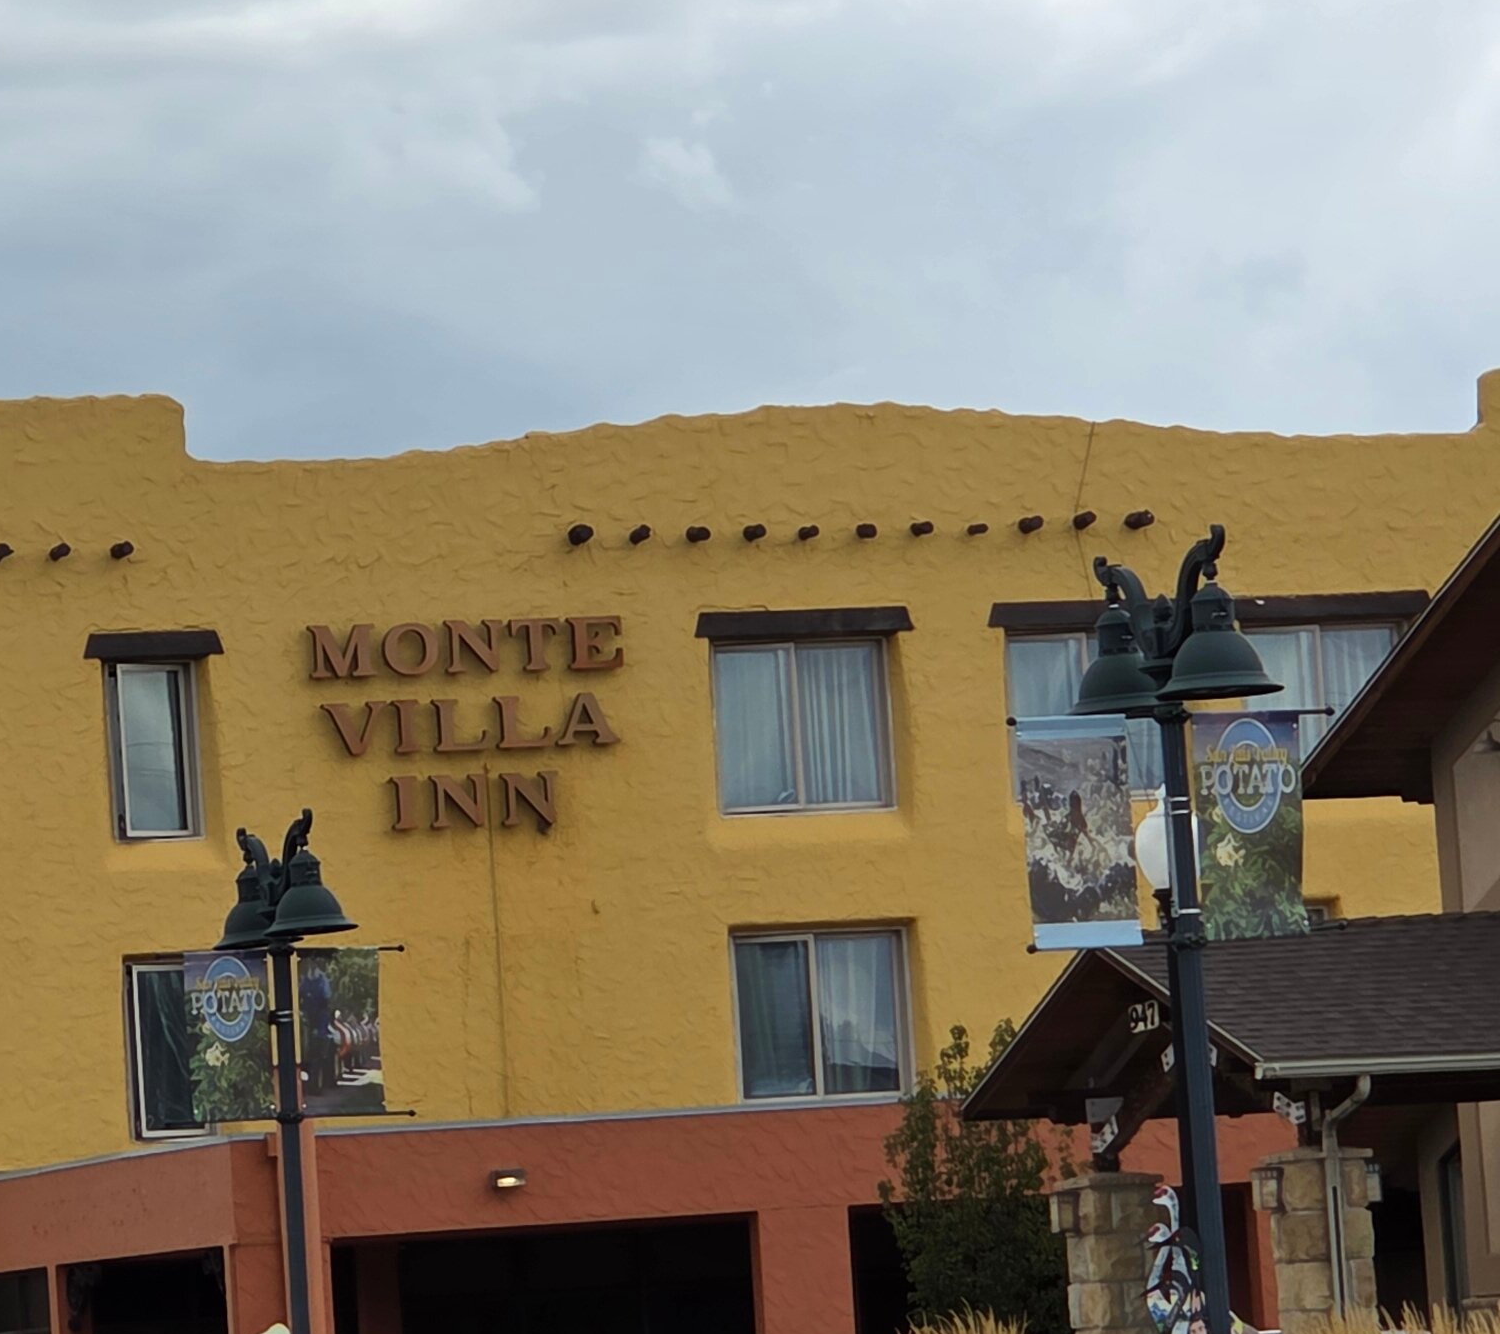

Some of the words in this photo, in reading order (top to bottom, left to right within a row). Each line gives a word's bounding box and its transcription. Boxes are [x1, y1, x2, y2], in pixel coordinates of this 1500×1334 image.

[306, 615, 624, 680] MONTE
[319, 692, 621, 757] VILLA
[389, 770, 558, 832] INN
[1200, 763, 1296, 796] POTATO
[191, 989, 265, 1016] POTATO
